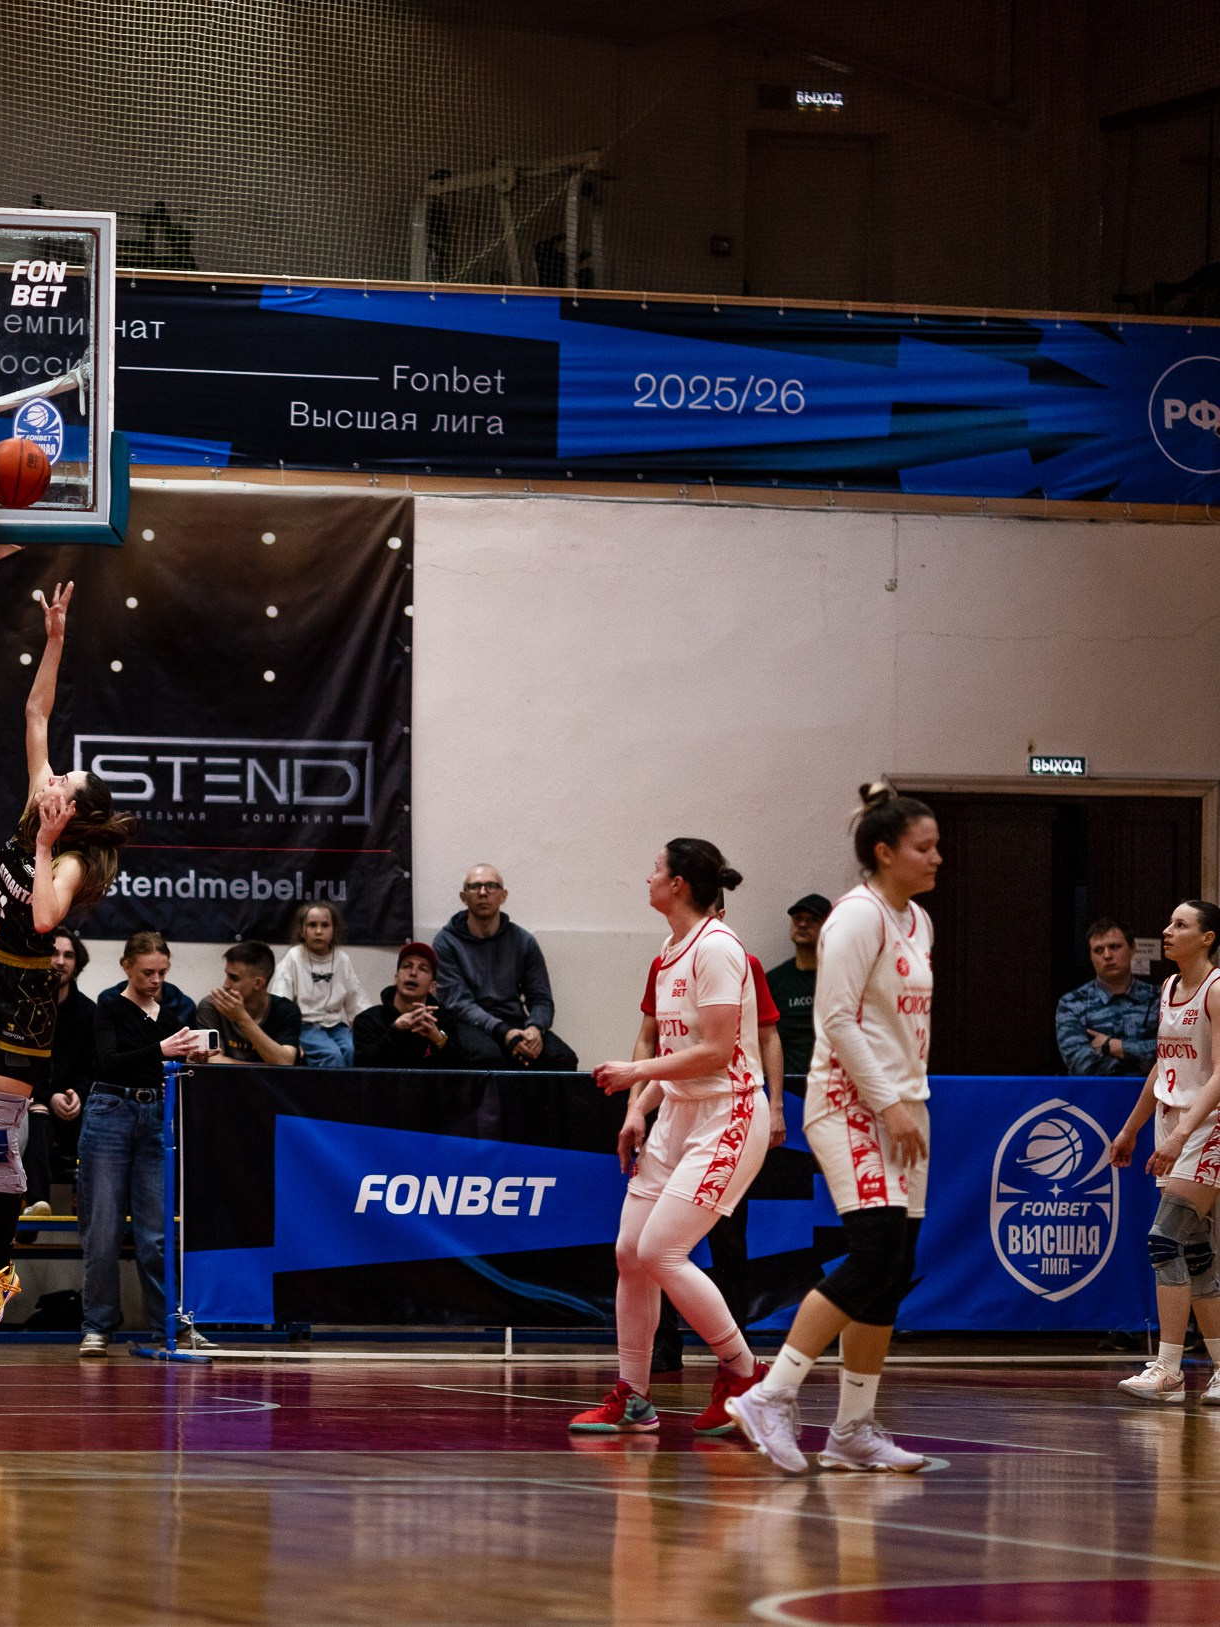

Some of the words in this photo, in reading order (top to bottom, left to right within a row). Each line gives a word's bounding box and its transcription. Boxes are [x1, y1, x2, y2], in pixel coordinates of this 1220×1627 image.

[10, 259, 67, 283] FON
[10, 284, 67, 307] BET
[393, 365, 506, 395] Fonbet
[633, 373, 806, 415] 2025/26
[289, 401, 418, 431] Высшая
[430, 412, 505, 435] лига
[1163, 398, 1220, 430] РФ
[1032, 758, 1083, 773] ВЫХОД
[91, 754, 361, 806] STEND
[114, 810, 207, 822] БЕЛЬНАЯ
[242, 812, 334, 824] КОМПАНИЯ
[105, 869, 347, 901] stendmebel.ru
[671, 988, 687, 998] BET
[673, 978, 687, 987] FON
[789, 996, 813, 1007] LACO
[1184, 1008, 1199, 1017] FON
[659, 1019, 689, 1037] ОСТЬ
[1182, 1017, 1199, 1025] BET
[1165, 1068, 1176, 1093] 9
[354, 1174, 557, 1217] FONBET
[1021, 1201, 1092, 1217] FONBET
[1008, 1224, 1100, 1256] ВЫСШАЯ
[1040, 1257, 1071, 1275] ЛИГА
